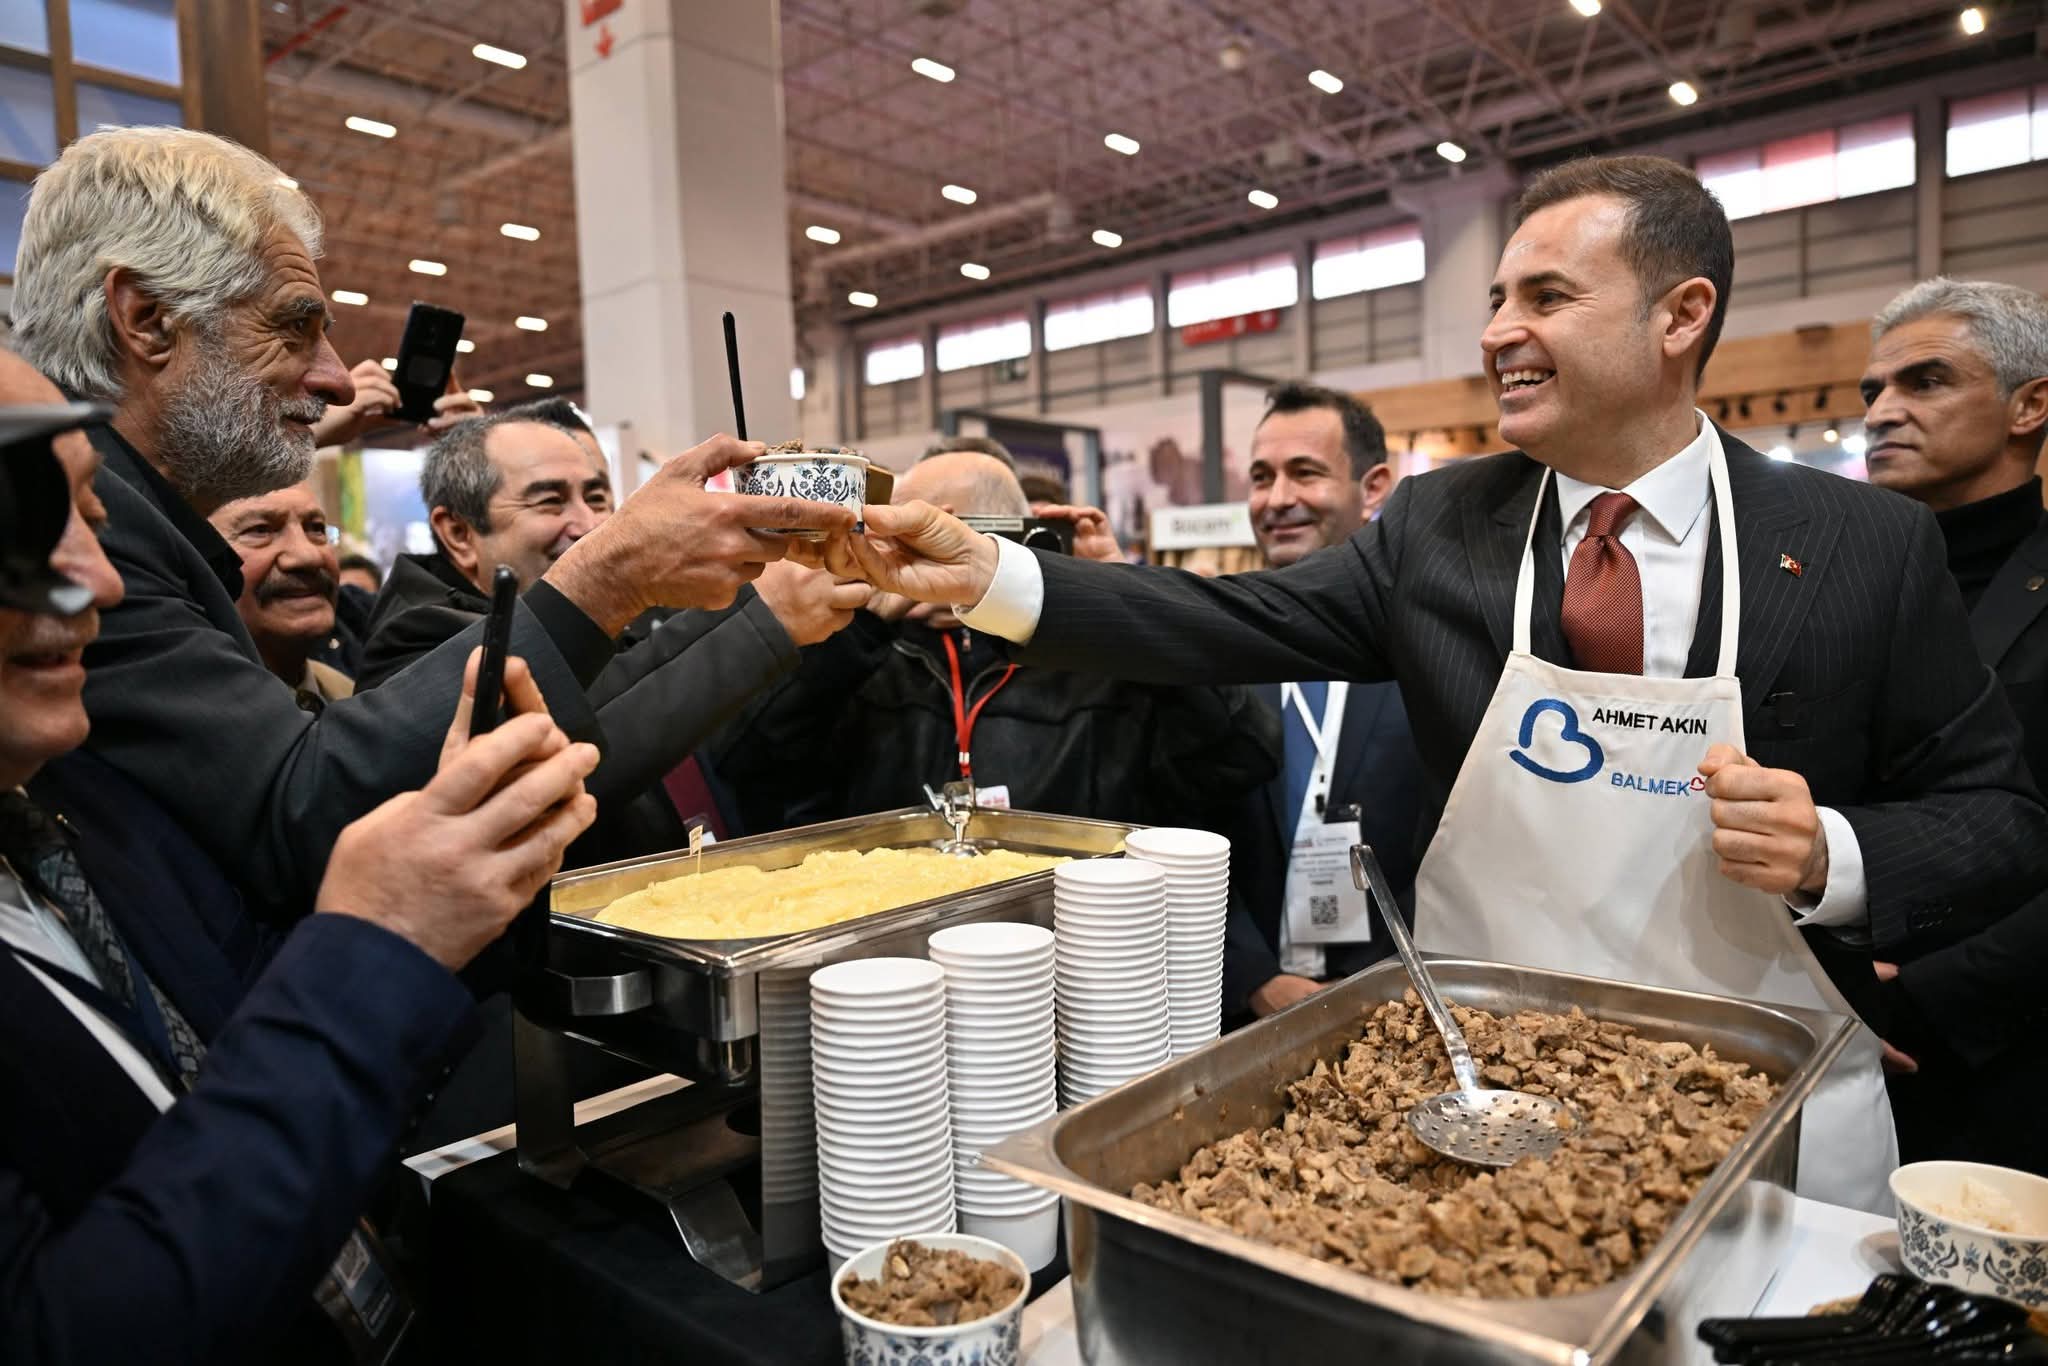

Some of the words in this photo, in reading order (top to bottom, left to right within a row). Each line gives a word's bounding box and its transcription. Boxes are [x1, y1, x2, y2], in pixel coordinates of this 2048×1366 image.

[1592, 708, 1658, 730] AHMET
[1660, 717, 1707, 735] AKIN
[1611, 772, 1690, 796] BALMEK
